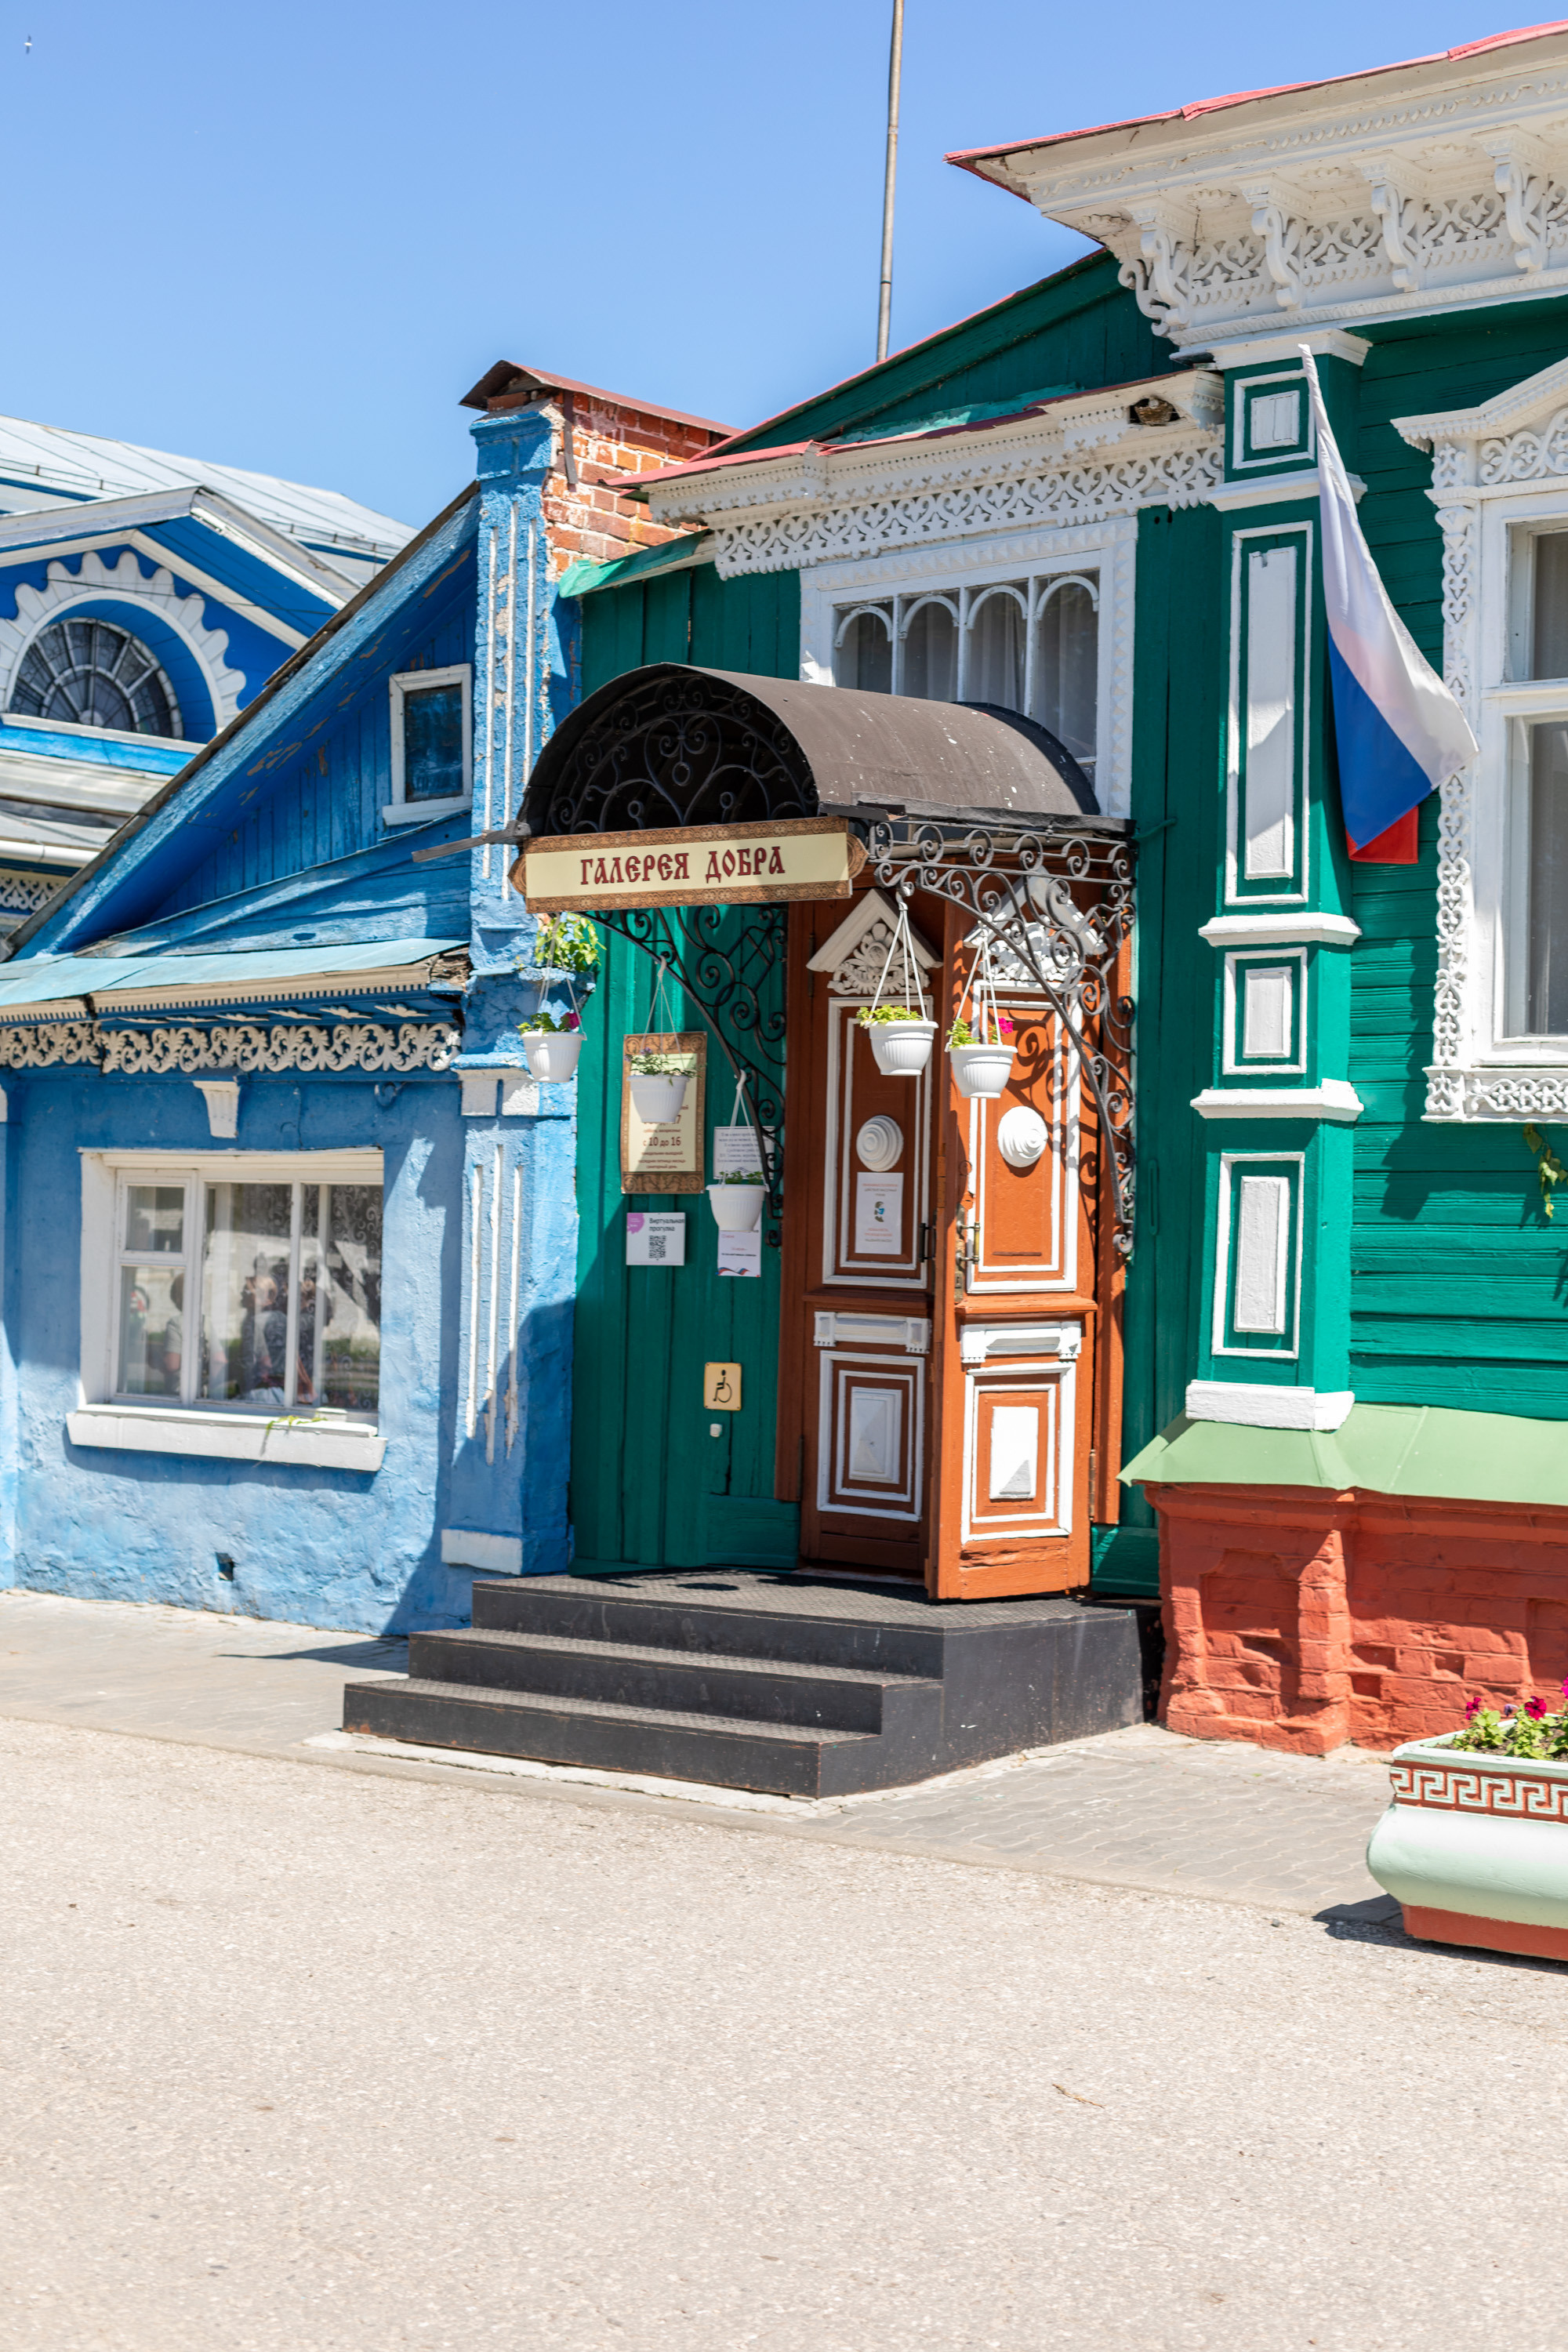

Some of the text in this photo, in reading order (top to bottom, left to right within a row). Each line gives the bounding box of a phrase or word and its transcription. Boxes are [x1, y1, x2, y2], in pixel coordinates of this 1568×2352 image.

[580, 846, 786, 885] ГАЛЕРЕЯ ДОБРА
[648, 1137, 659, 1146] 10
[671, 1136, 681, 1145] 16
